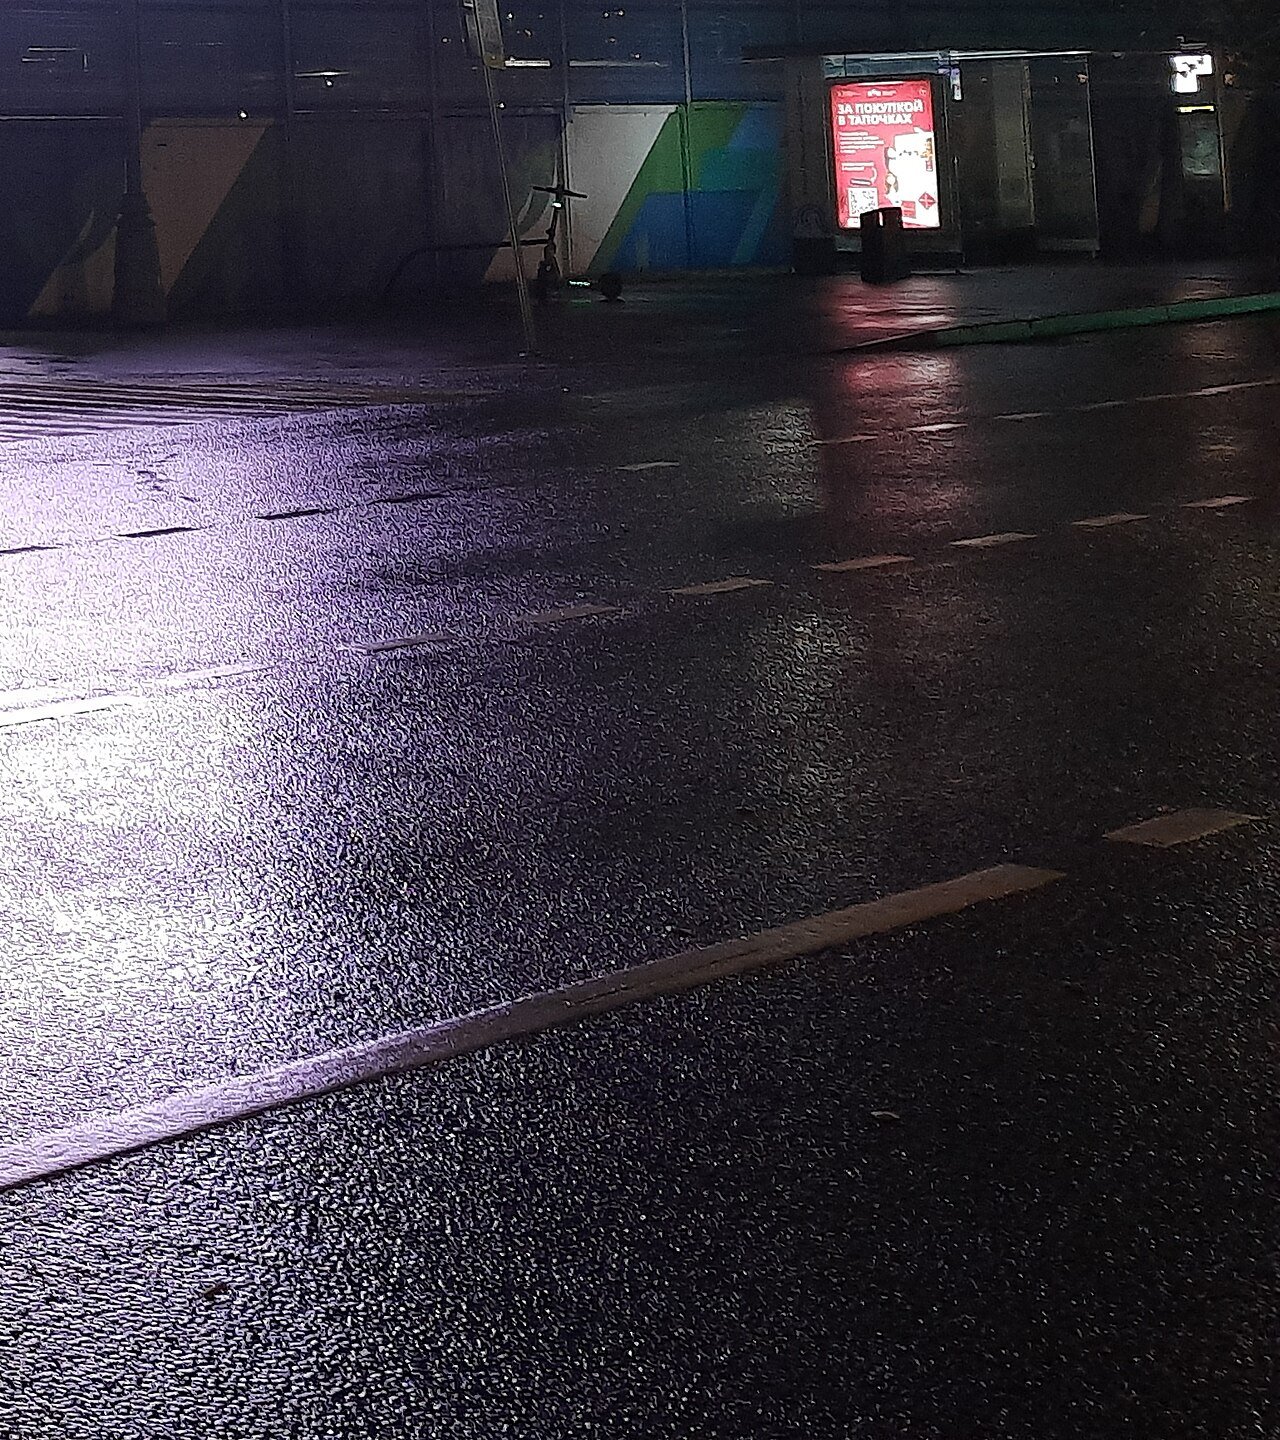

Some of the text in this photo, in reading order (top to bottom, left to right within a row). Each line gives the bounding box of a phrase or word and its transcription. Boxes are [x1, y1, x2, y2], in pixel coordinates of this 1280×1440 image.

[837, 98, 924, 115] ЗА ПОКУПКОЙ
[838, 113, 913, 126] В ТАПОЧКАХ
